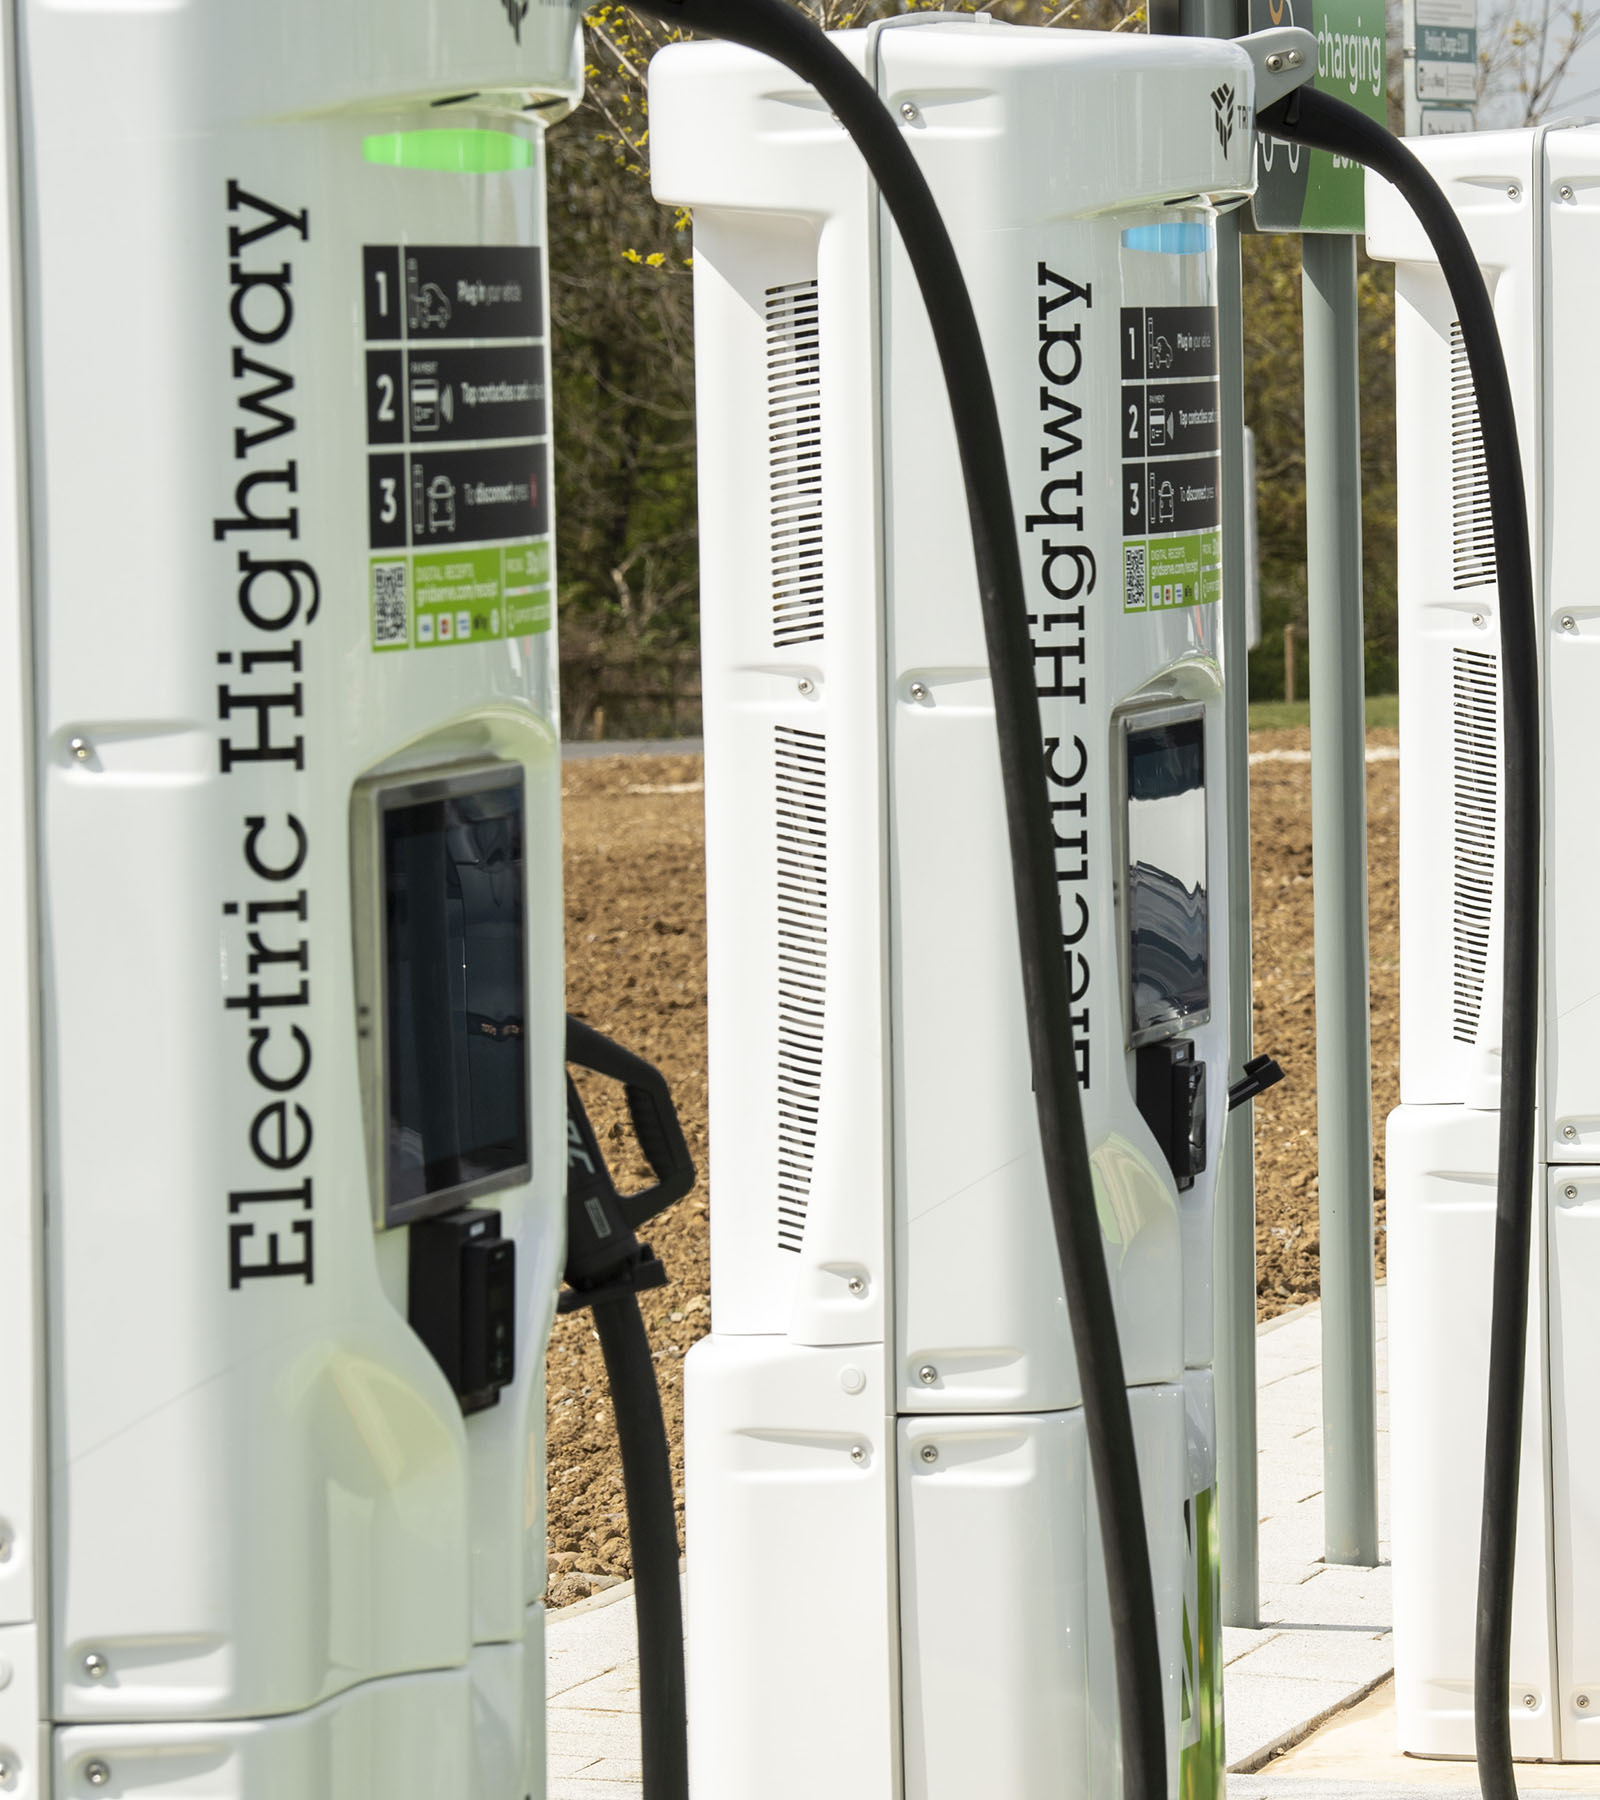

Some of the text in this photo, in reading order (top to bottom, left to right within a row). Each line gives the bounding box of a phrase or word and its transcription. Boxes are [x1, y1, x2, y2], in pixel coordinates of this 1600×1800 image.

[1318, 14, 1381, 97] charging
[375, 271, 388, 317] 1
[1128, 327, 1135, 360] 1
[376, 374, 395, 422] 2
[1128, 405, 1139, 439] 2
[380, 477, 397, 523] 3
[1129, 482, 1140, 516] 3
[1026, 262, 1096, 1090] ectric Highway
[213, 179, 321, 1291] Electric Highway
